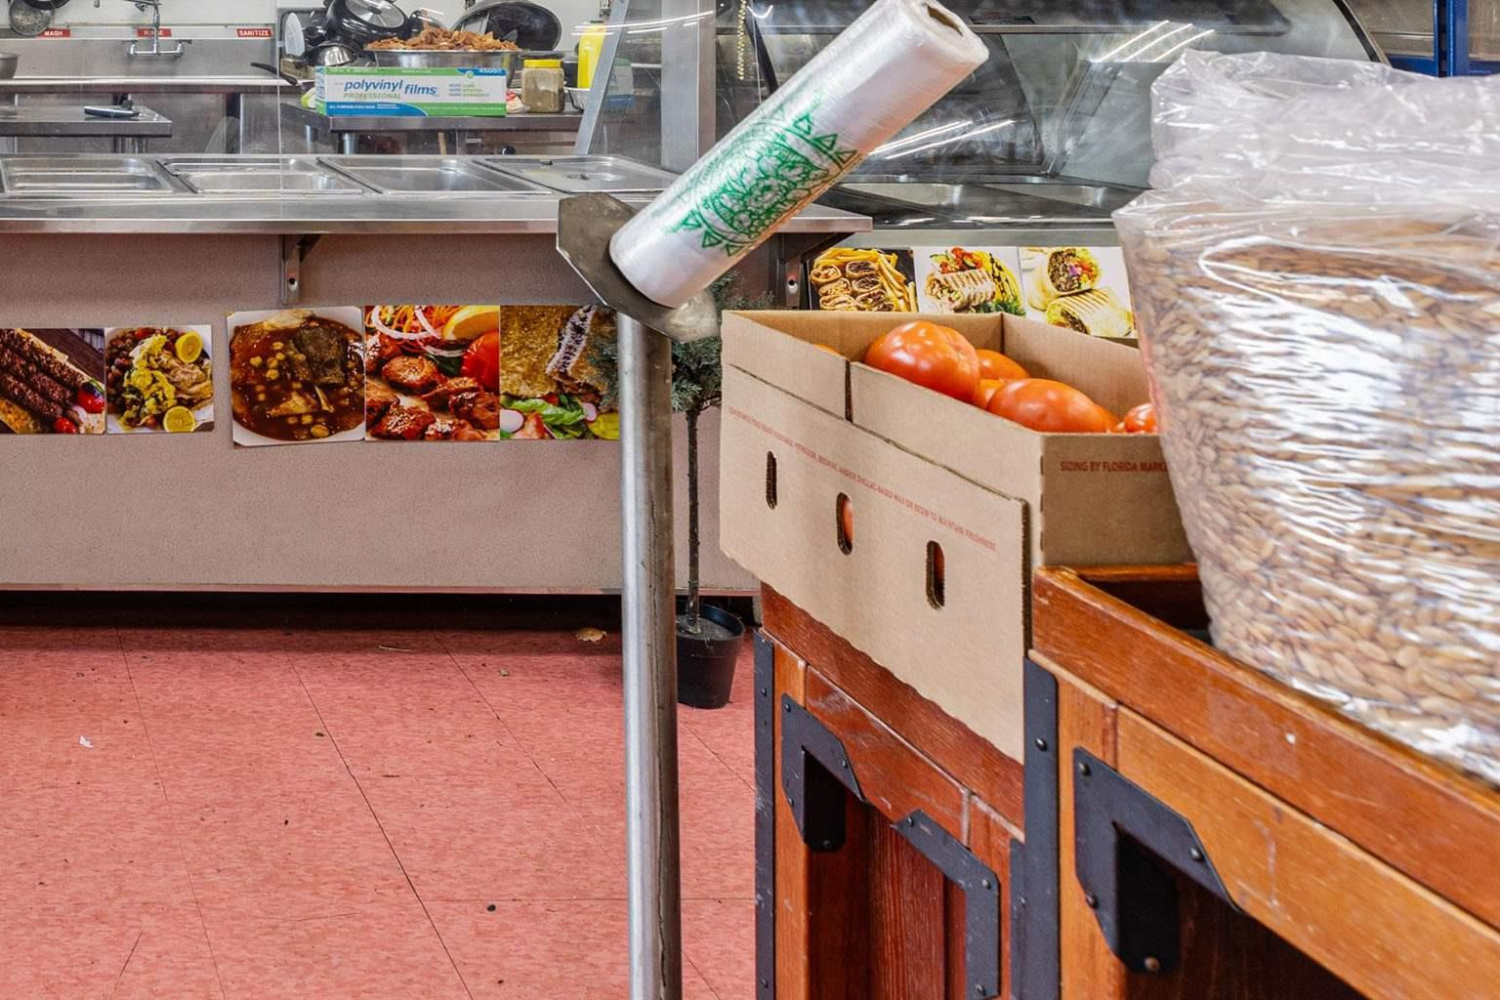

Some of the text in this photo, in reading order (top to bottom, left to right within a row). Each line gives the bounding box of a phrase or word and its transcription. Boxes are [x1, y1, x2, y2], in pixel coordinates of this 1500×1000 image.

[344, 80, 438, 95] polyvinyl films
[1060, 461, 1088, 472] SIZING
[1090, 461, 1101, 472] BY
[1102, 461, 1138, 472] FLORIDA
